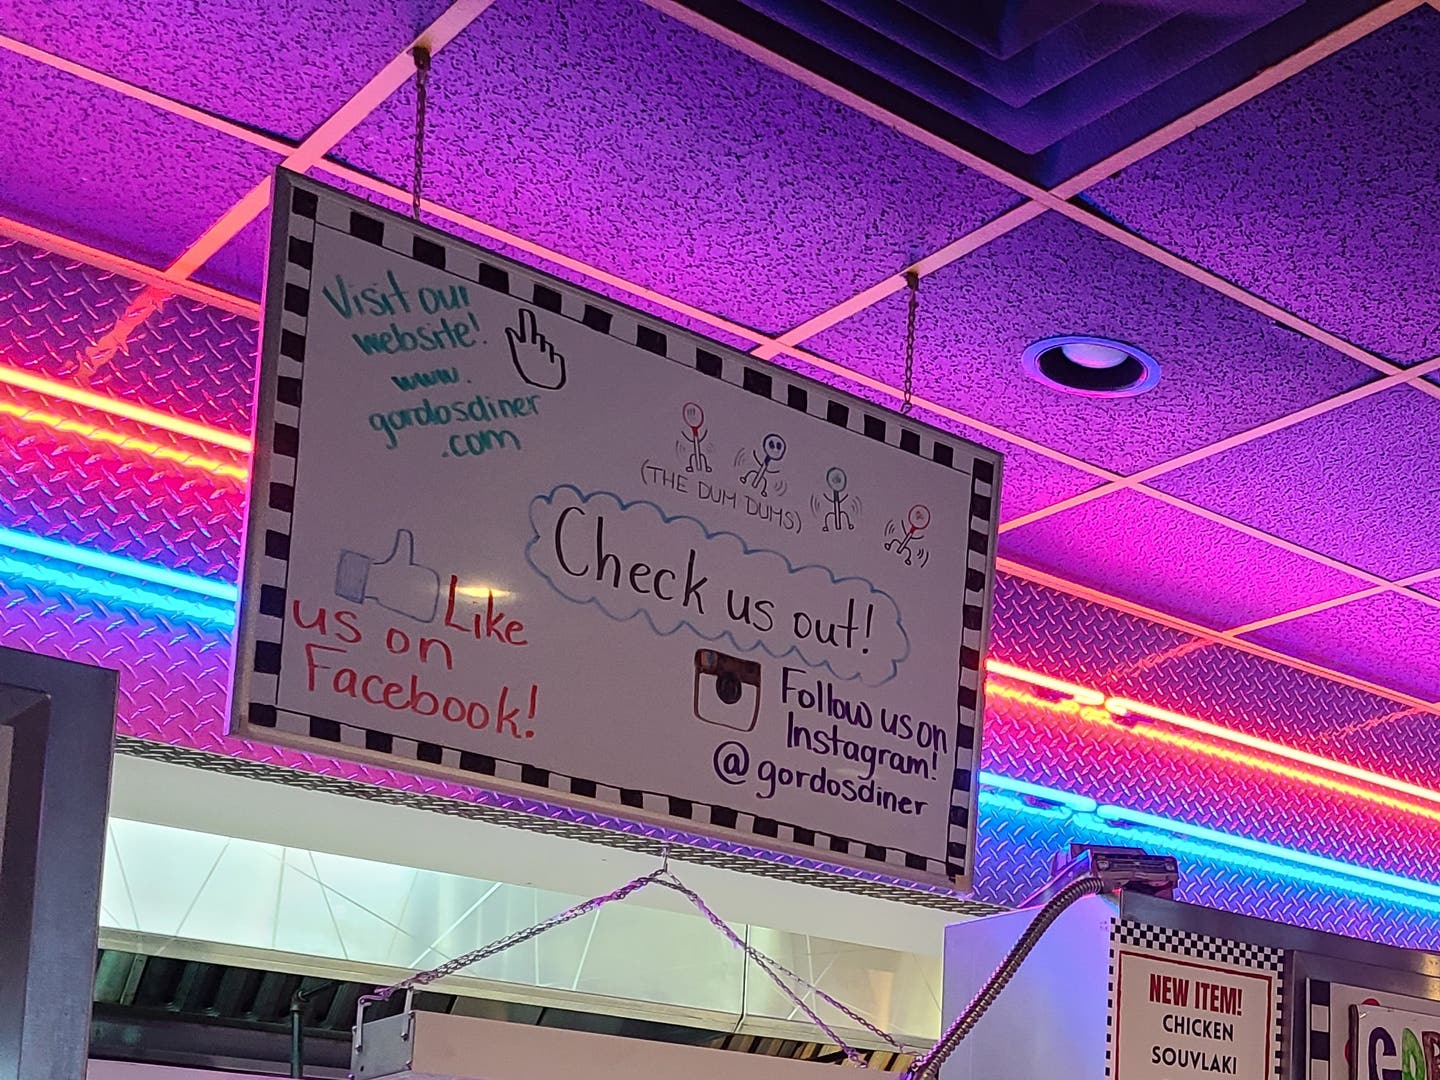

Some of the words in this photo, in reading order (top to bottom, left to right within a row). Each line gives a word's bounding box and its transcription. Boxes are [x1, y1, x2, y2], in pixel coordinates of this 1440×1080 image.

[323, 270, 410, 319] Visit
[418, 284, 473, 315] our
[352, 312, 488, 356] website!
[391, 366, 472, 391] www.
[368, 394, 542, 450] gordosdiner
[441, 428, 521, 458] .com
[640, 458, 689, 494] (THE
[697, 484, 737, 510] DUM
[745, 495, 802, 534] DUMS)
[554, 506, 708, 615] Check
[727, 588, 776, 632] us
[793, 598, 874, 655] out!
[292, 599, 363, 644] us
[386, 627, 453, 671] on
[444, 574, 529, 647] Like
[304, 642, 539, 740] Facebook!
[781, 666, 873, 729] Follow
[880, 708, 914, 740] us
[916, 720, 948, 754] on
[786, 711, 938, 781] Instagram!
[1149, 973, 1190, 1008] NEW
[1194, 981, 1243, 1016] ITEM!
[1162, 1014, 1234, 1041] CHICKEN
[1151, 1045, 1237, 1075] SOUVLAKI
